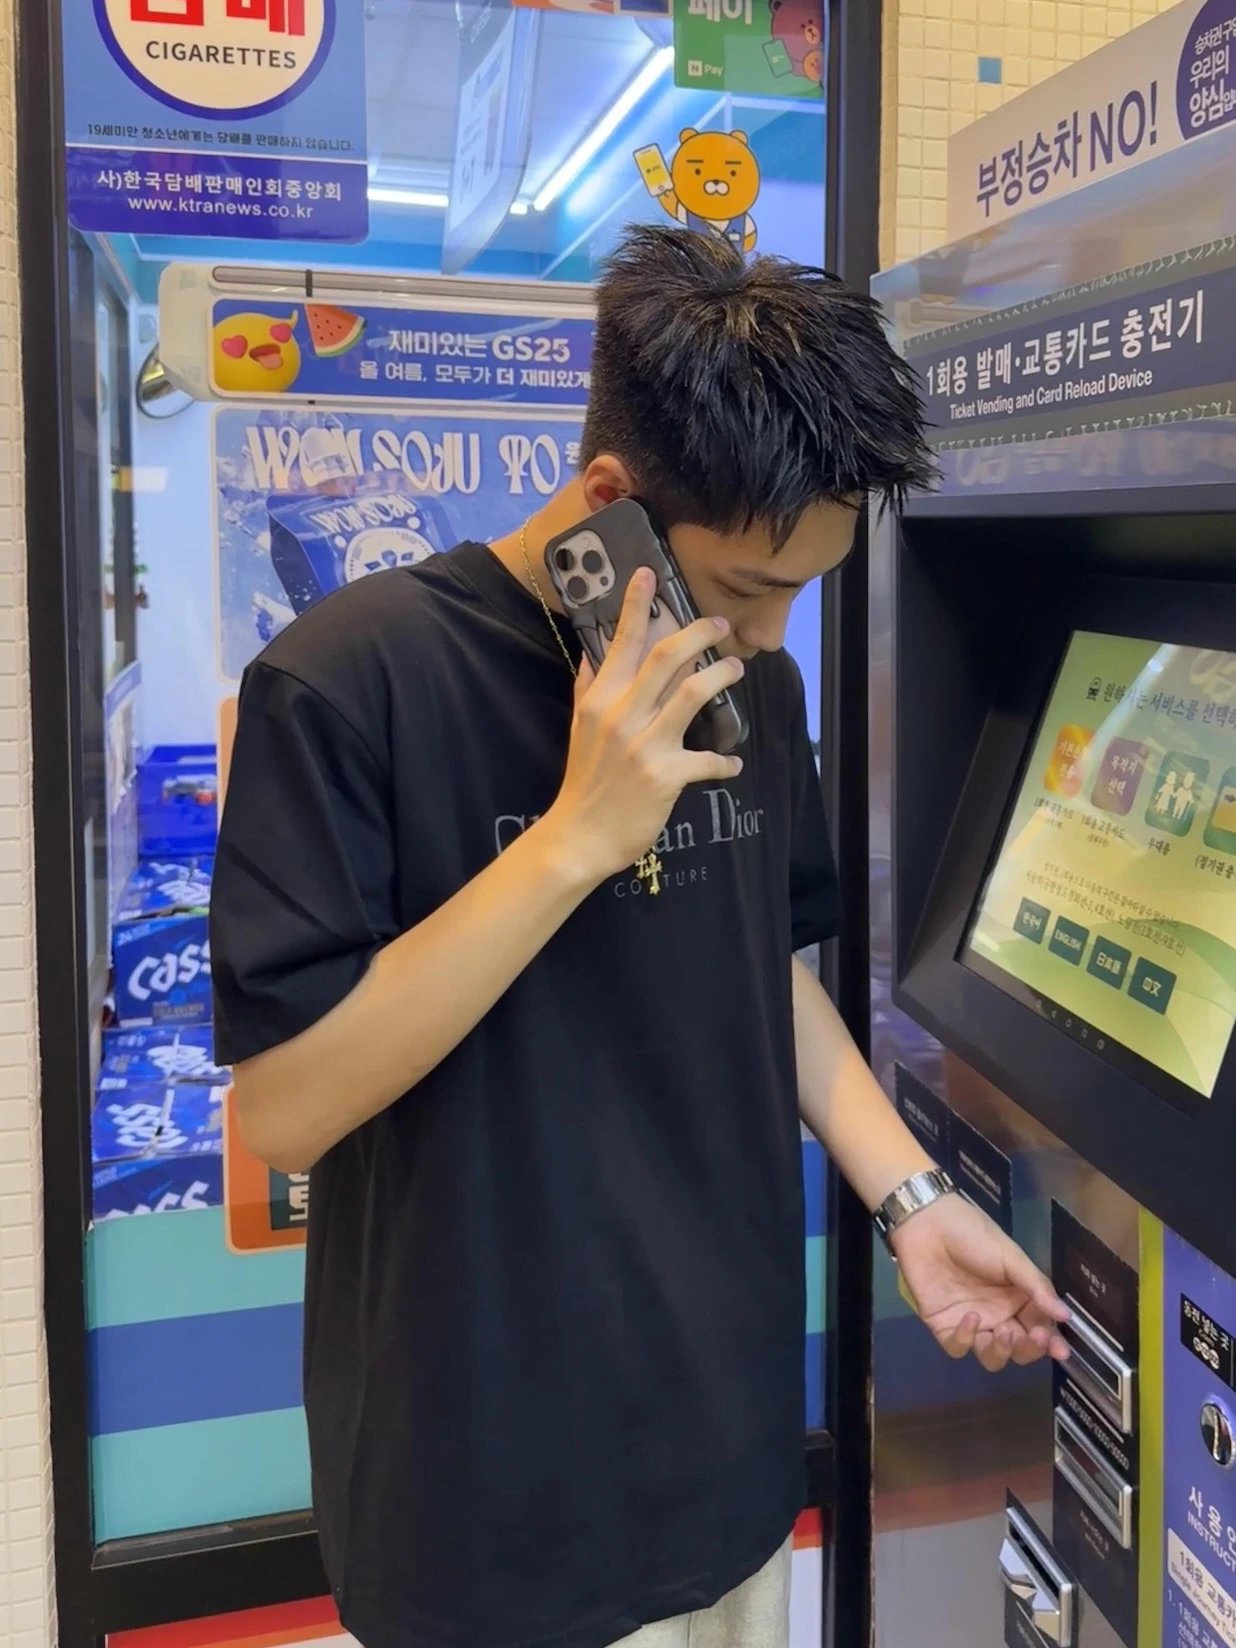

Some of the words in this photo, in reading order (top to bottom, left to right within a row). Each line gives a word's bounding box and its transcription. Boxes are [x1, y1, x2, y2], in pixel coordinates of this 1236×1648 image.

[145, 41, 297, 69] CIGARETTES
[1195, 24, 1222, 55] 승차권
[704, 64, 723, 77] Pay
[1189, 45, 1229, 88] 우리의
[87, 124, 138, 137] 19세미만
[141, 126, 214, 143] 청소년에게는
[217, 131, 252, 146] 담배를
[255, 133, 302, 148] 판매하지
[305, 136, 354, 152] 않습니다.
[976, 111, 1082, 218] 부정승차
[1090, 81, 1158, 171] NO!
[128, 196, 314, 218] www.ktranews.co.kr
[388, 330, 488, 358] 재미있는
[492, 336, 570, 363] GS25
[926, 356, 969, 397] 1회용
[976, 318, 1112, 391] 발매·교통카드
[1120, 289, 1204, 359] 충전기
[360, 360, 378, 380] 올
[385, 362, 427, 382] 여름,
[436, 363, 491, 384] 모두가
[497, 367, 514, 386] 더
[950, 402, 975, 421] Ticket
[977, 395, 1014, 417] Vending
[1015, 389, 1035, 409] and
[1036, 381, 1063, 406] Card
[1065, 375, 1106, 403] Reload
[1108, 369, 1153, 395] Device
[372, 429, 481, 494] SOJU
[499, 434, 560, 494] TO
[1150, 692, 1200, 720] 서비스를
[702, 788, 764, 845] Dior
[614, 866, 708, 898] COTURE
[1054, 928, 1082, 951] ENGLISH
